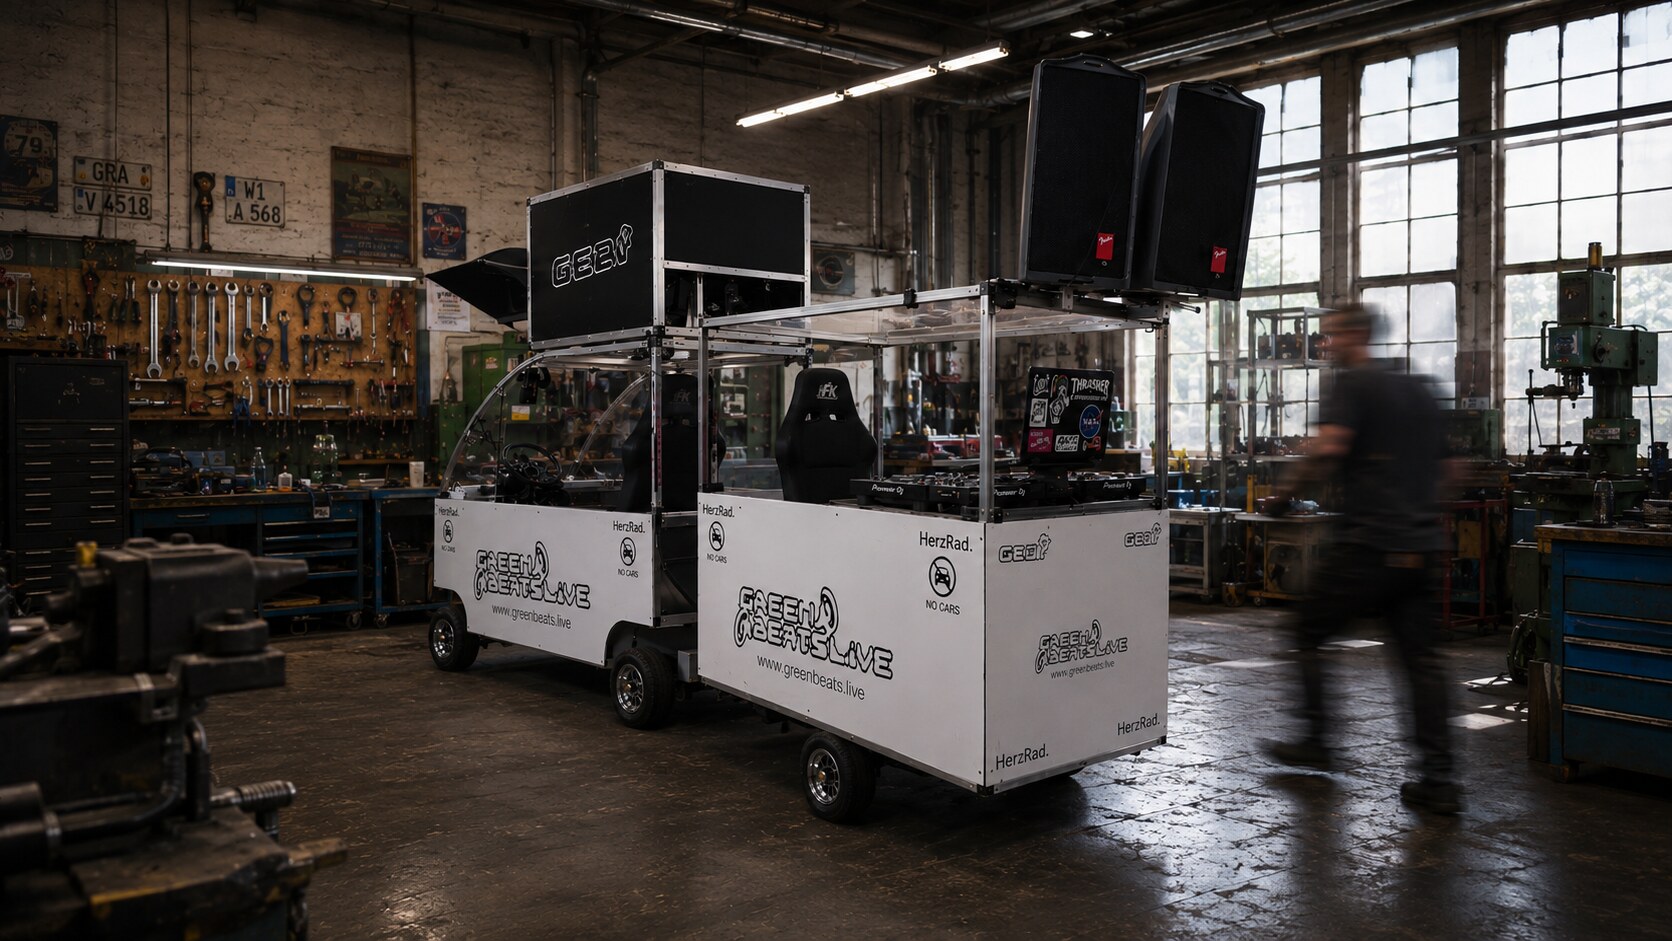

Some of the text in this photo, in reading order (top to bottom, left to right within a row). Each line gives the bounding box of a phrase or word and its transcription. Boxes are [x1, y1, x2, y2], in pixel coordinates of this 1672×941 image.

[92, 162, 129, 184] GRA
[244, 181, 265, 200] W1
[85, 191, 149, 216] V 4518
[233, 202, 280, 223] A 568
[702, 503, 735, 518] HerzRad.
[613, 520, 646, 534] HerzRad.
[919, 530, 974, 552] HerzRad.
[491, 604, 572, 630] www.greenbeats.live
[926, 600, 961, 615] NO CARS
[757, 655, 865, 700] www.greenbeats.live
[1117, 713, 1161, 736] HerzRad.
[995, 743, 1049, 770] HerzRad.
